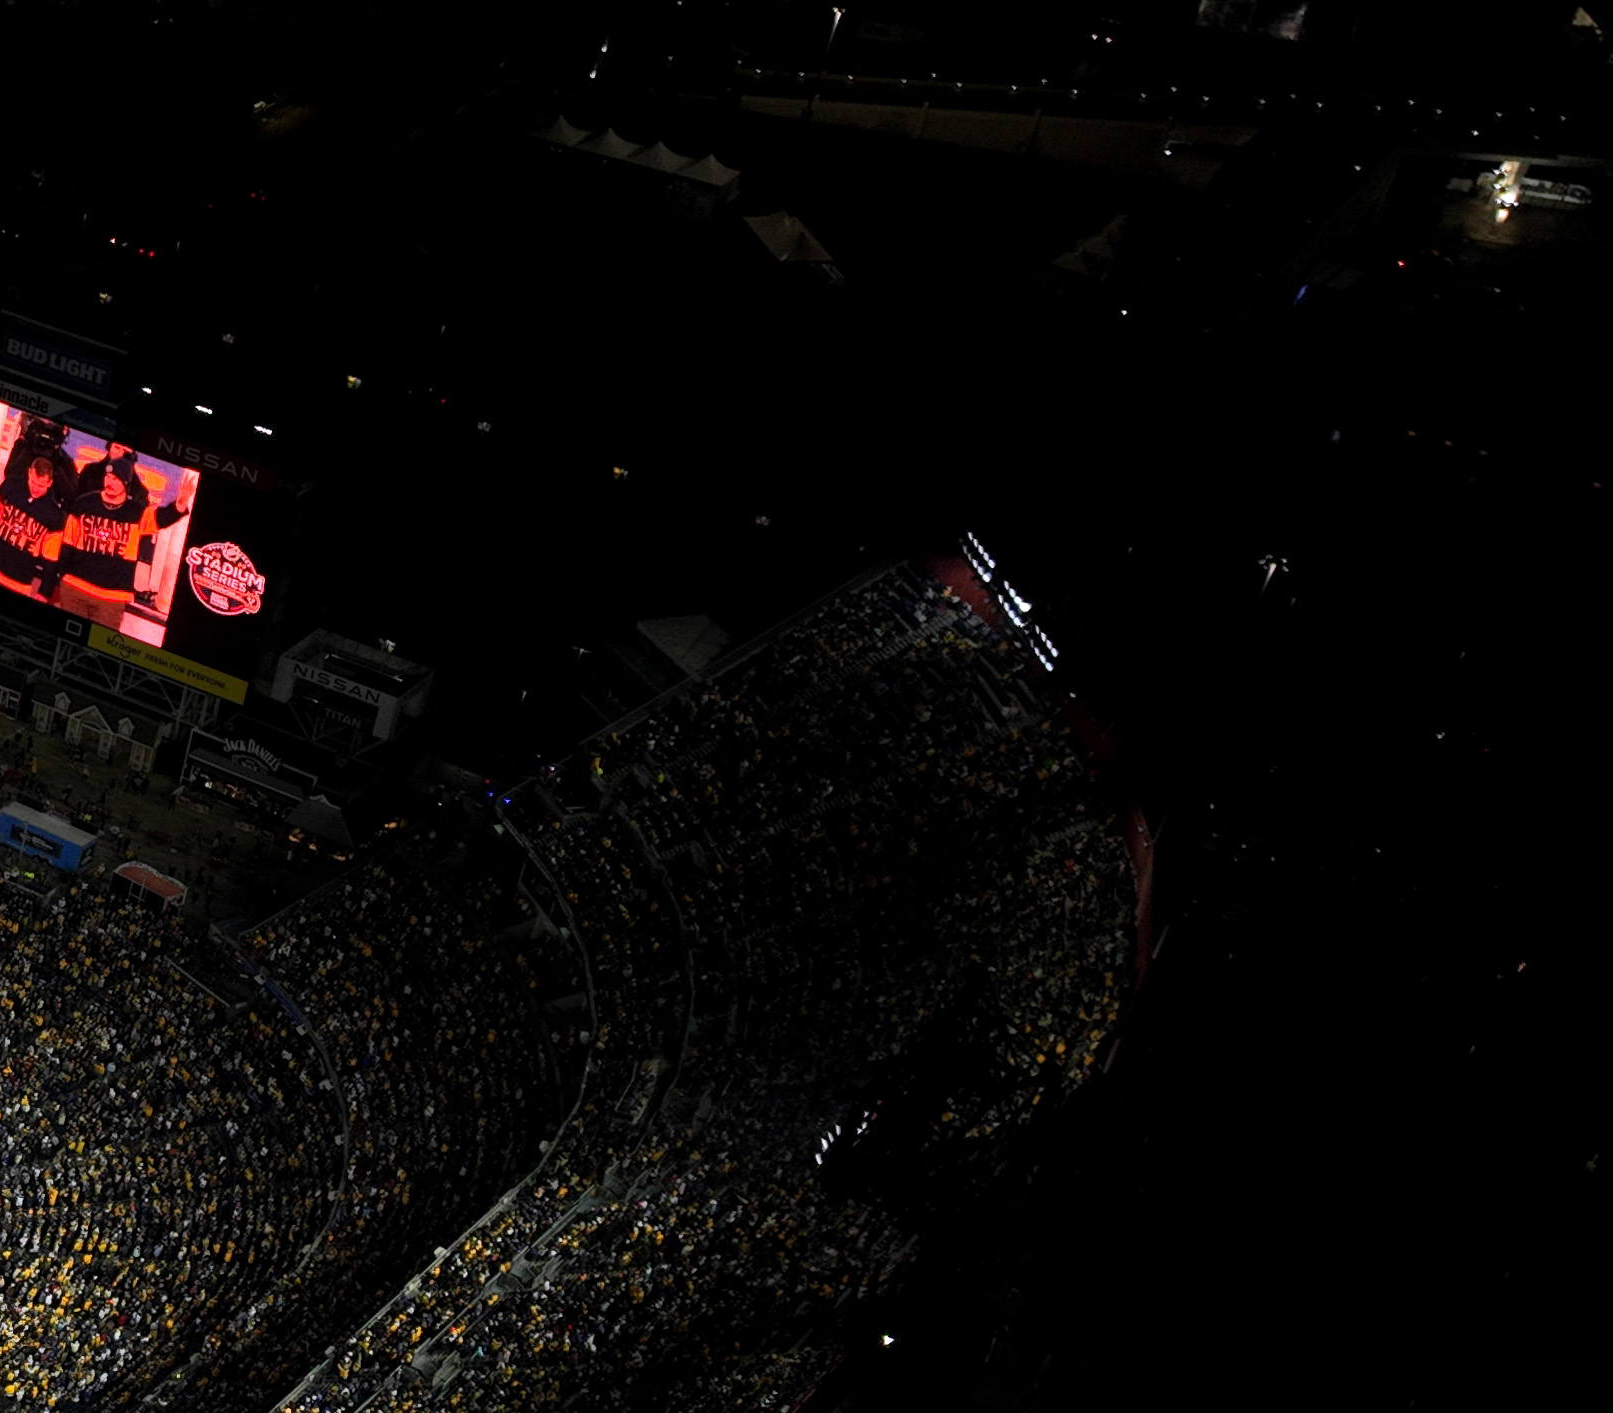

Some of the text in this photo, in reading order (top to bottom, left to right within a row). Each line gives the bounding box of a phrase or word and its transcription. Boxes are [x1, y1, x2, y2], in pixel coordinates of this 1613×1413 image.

[7, 338, 107, 386] BUD LIGHT
[158, 437, 259, 483] NISSAN
[190, 550, 263, 593] STADIUM SERIES
[107, 635, 141, 658] Kroger
[294, 663, 381, 703] NISSAN
[325, 707, 362, 729] TITAN
